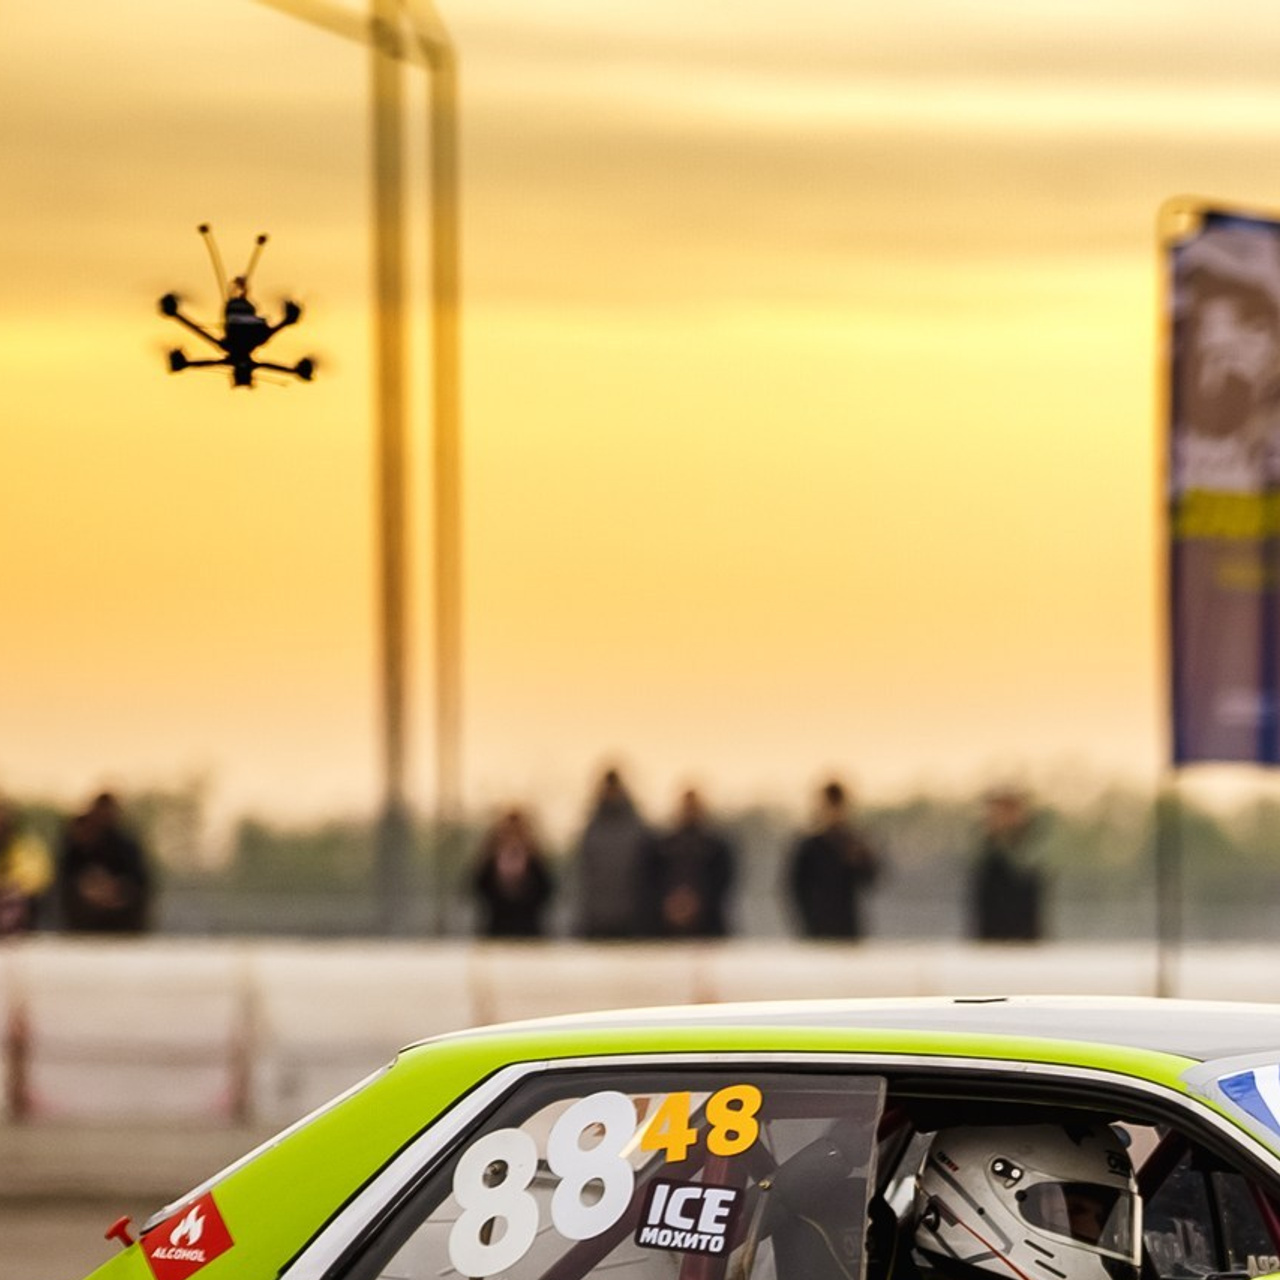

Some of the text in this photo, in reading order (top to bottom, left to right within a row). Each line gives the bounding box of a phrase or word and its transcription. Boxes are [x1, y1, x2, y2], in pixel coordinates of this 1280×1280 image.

[646, 1184, 736, 1234] ICE
[639, 1226, 726, 1253] МОХИТО
[151, 1246, 206, 1263] ALCOHOL
